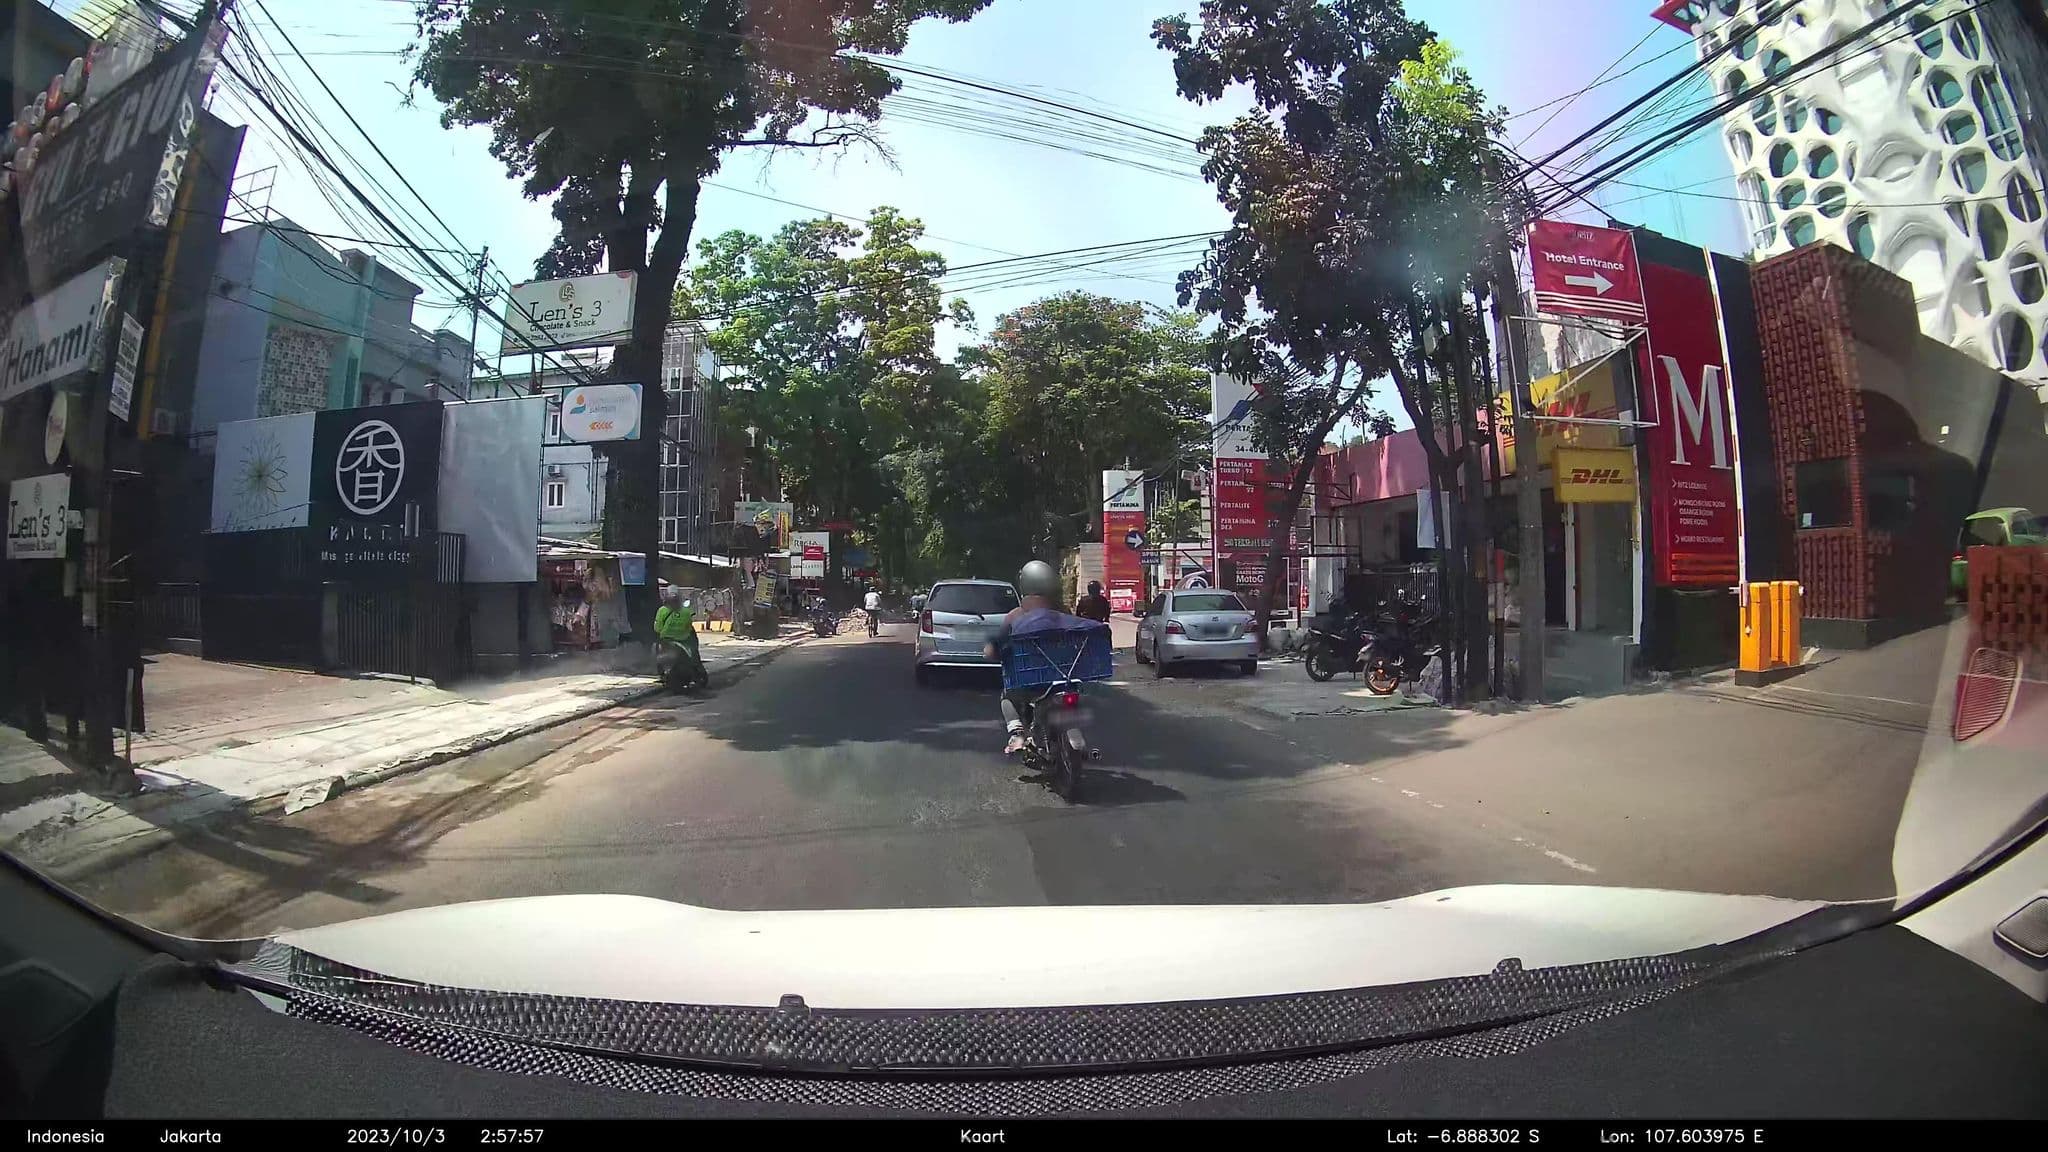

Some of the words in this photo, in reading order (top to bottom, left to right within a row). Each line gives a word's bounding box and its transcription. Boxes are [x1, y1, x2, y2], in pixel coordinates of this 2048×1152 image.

[103, 56, 193, 165] GYU
[1545, 251, 1577, 265] Hotel
[1579, 255, 1625, 271] Entrance
[527, 301, 583, 323] Len's
[591, 300, 602, 317] 3
[5, 304, 95, 389] Hanami
[1657, 354, 1733, 470] M
[1571, 468, 1624, 484] DHL
[9, 500, 51, 539] Len's
[55, 504, 66, 537] 3
